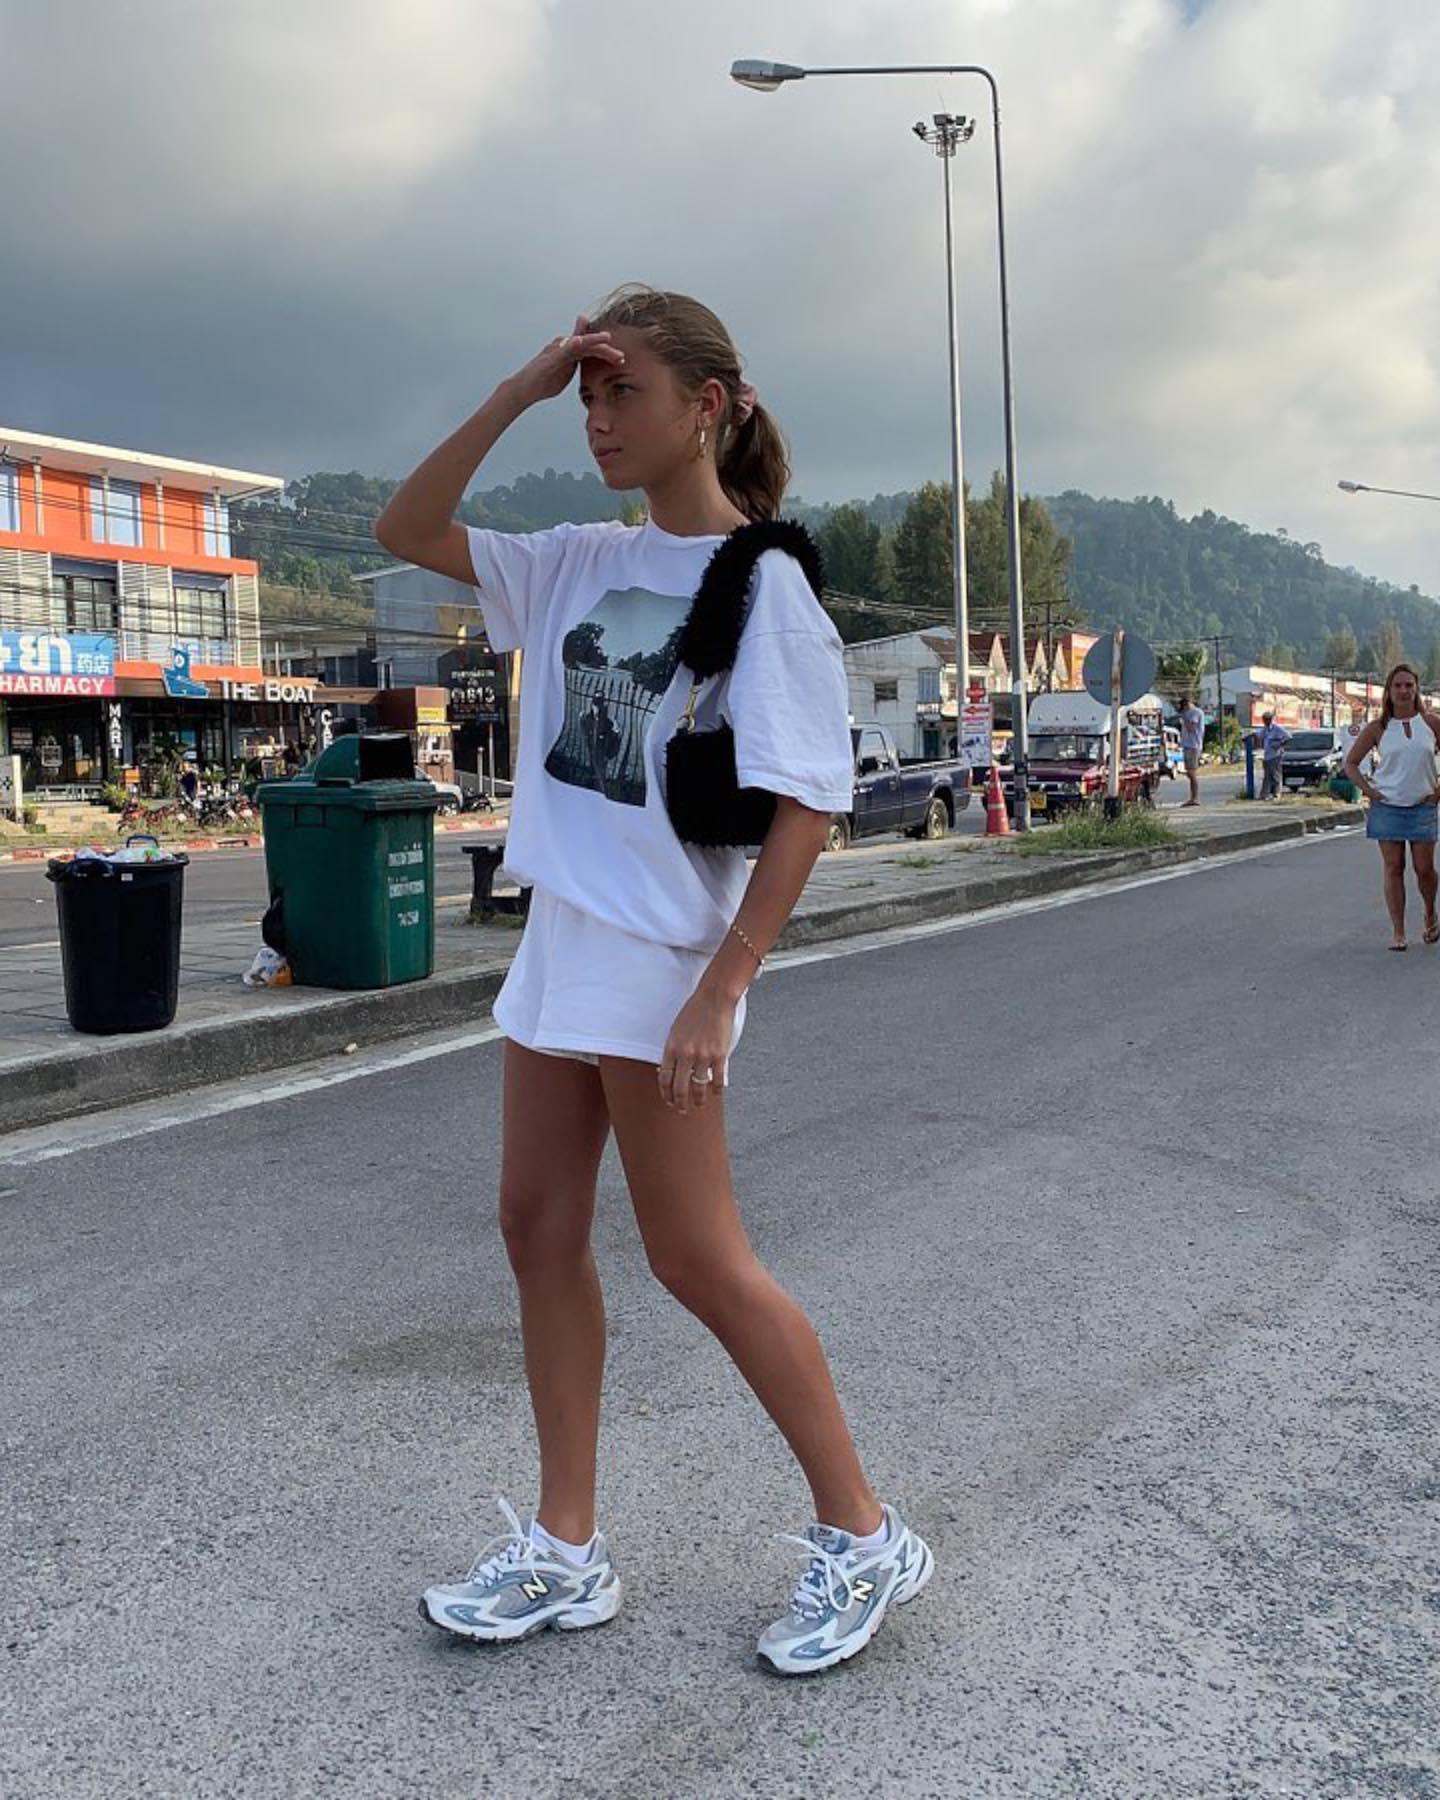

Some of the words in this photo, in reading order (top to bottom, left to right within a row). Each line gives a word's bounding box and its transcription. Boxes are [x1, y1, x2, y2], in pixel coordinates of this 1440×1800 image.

[220, 677, 259, 700] THE
[265, 680, 317, 703] BOAT
[109, 703, 123, 758] MART
[521, 1574, 550, 1601] N
[853, 1578, 876, 1602] N
